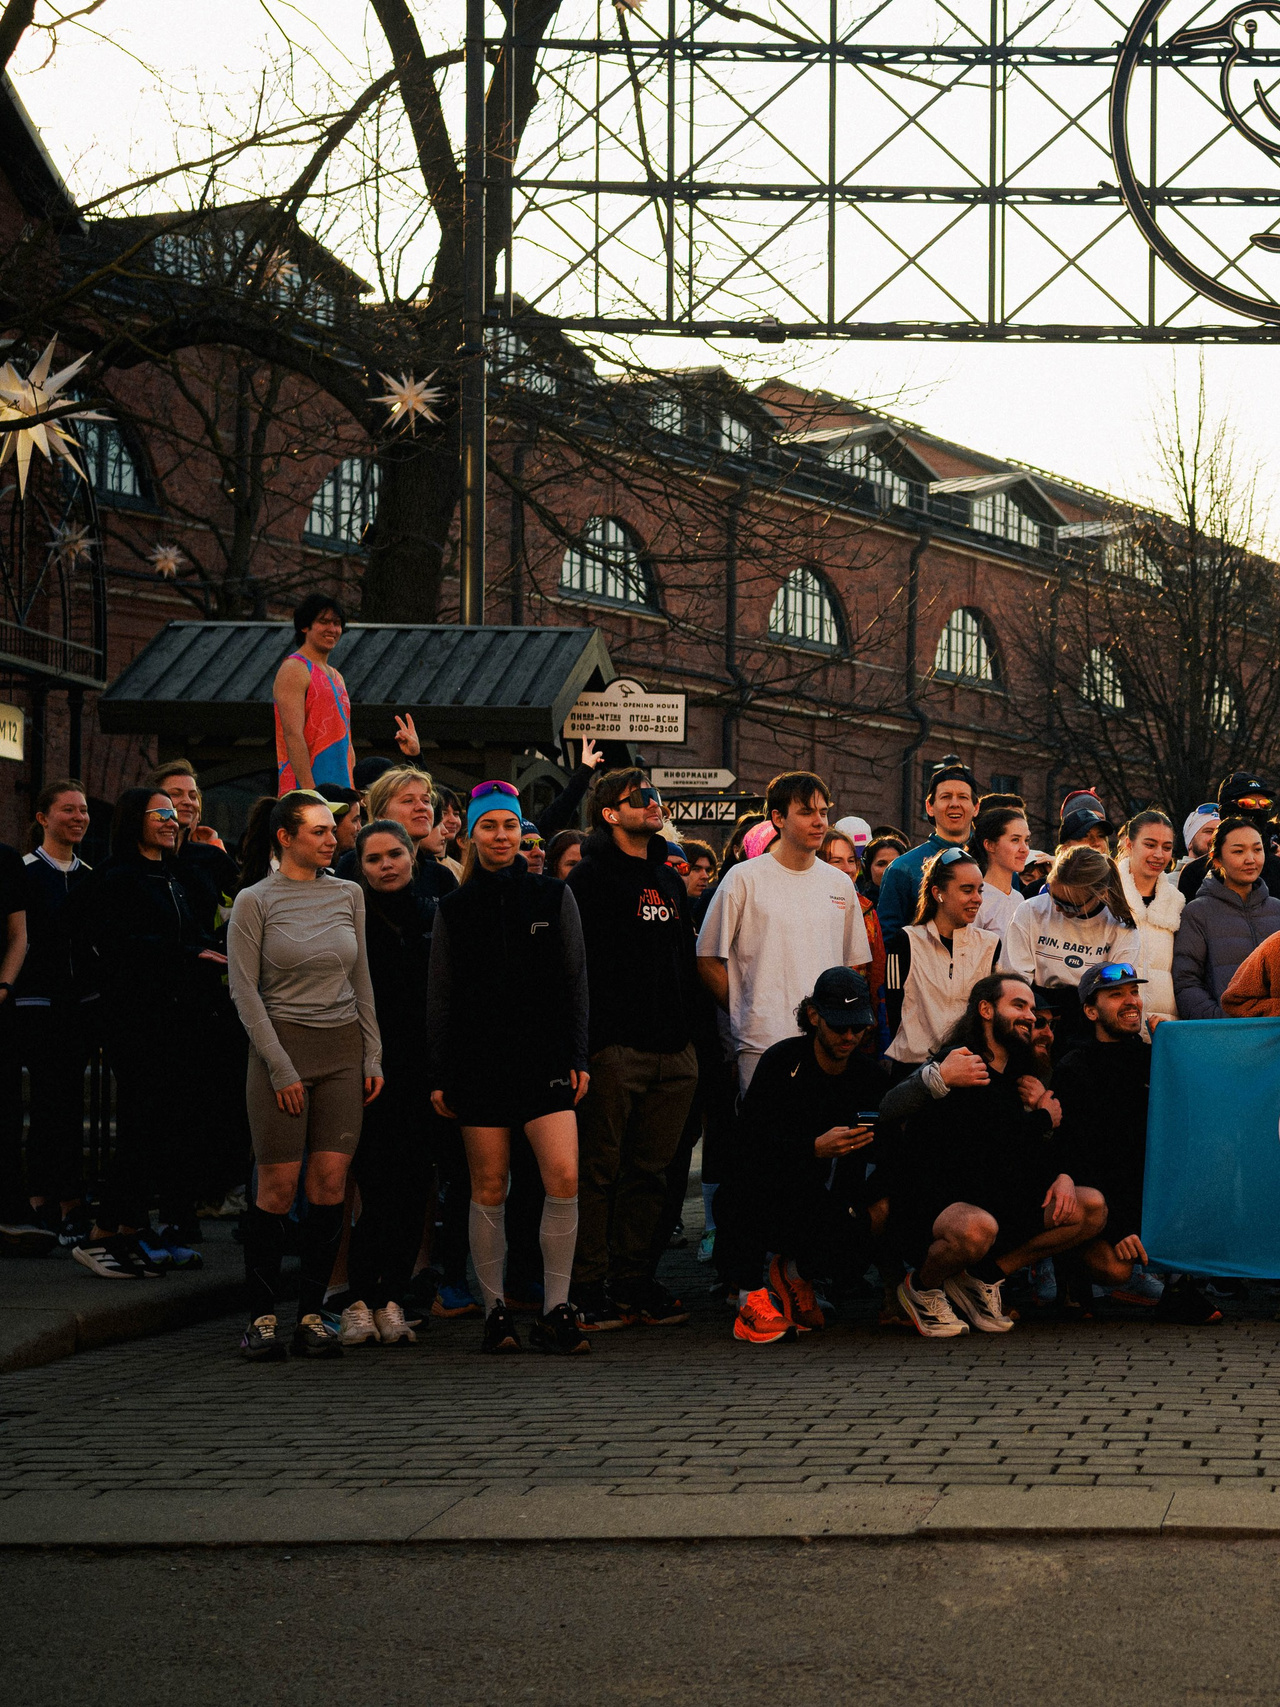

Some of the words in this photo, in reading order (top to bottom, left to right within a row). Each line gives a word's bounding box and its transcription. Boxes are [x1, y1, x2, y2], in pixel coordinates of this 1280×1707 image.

[9, 720, 18, 743] 12
[663, 771, 719, 780] ИНФОРМАЦИЯ
[1062, 941, 1093, 956] BABY,
